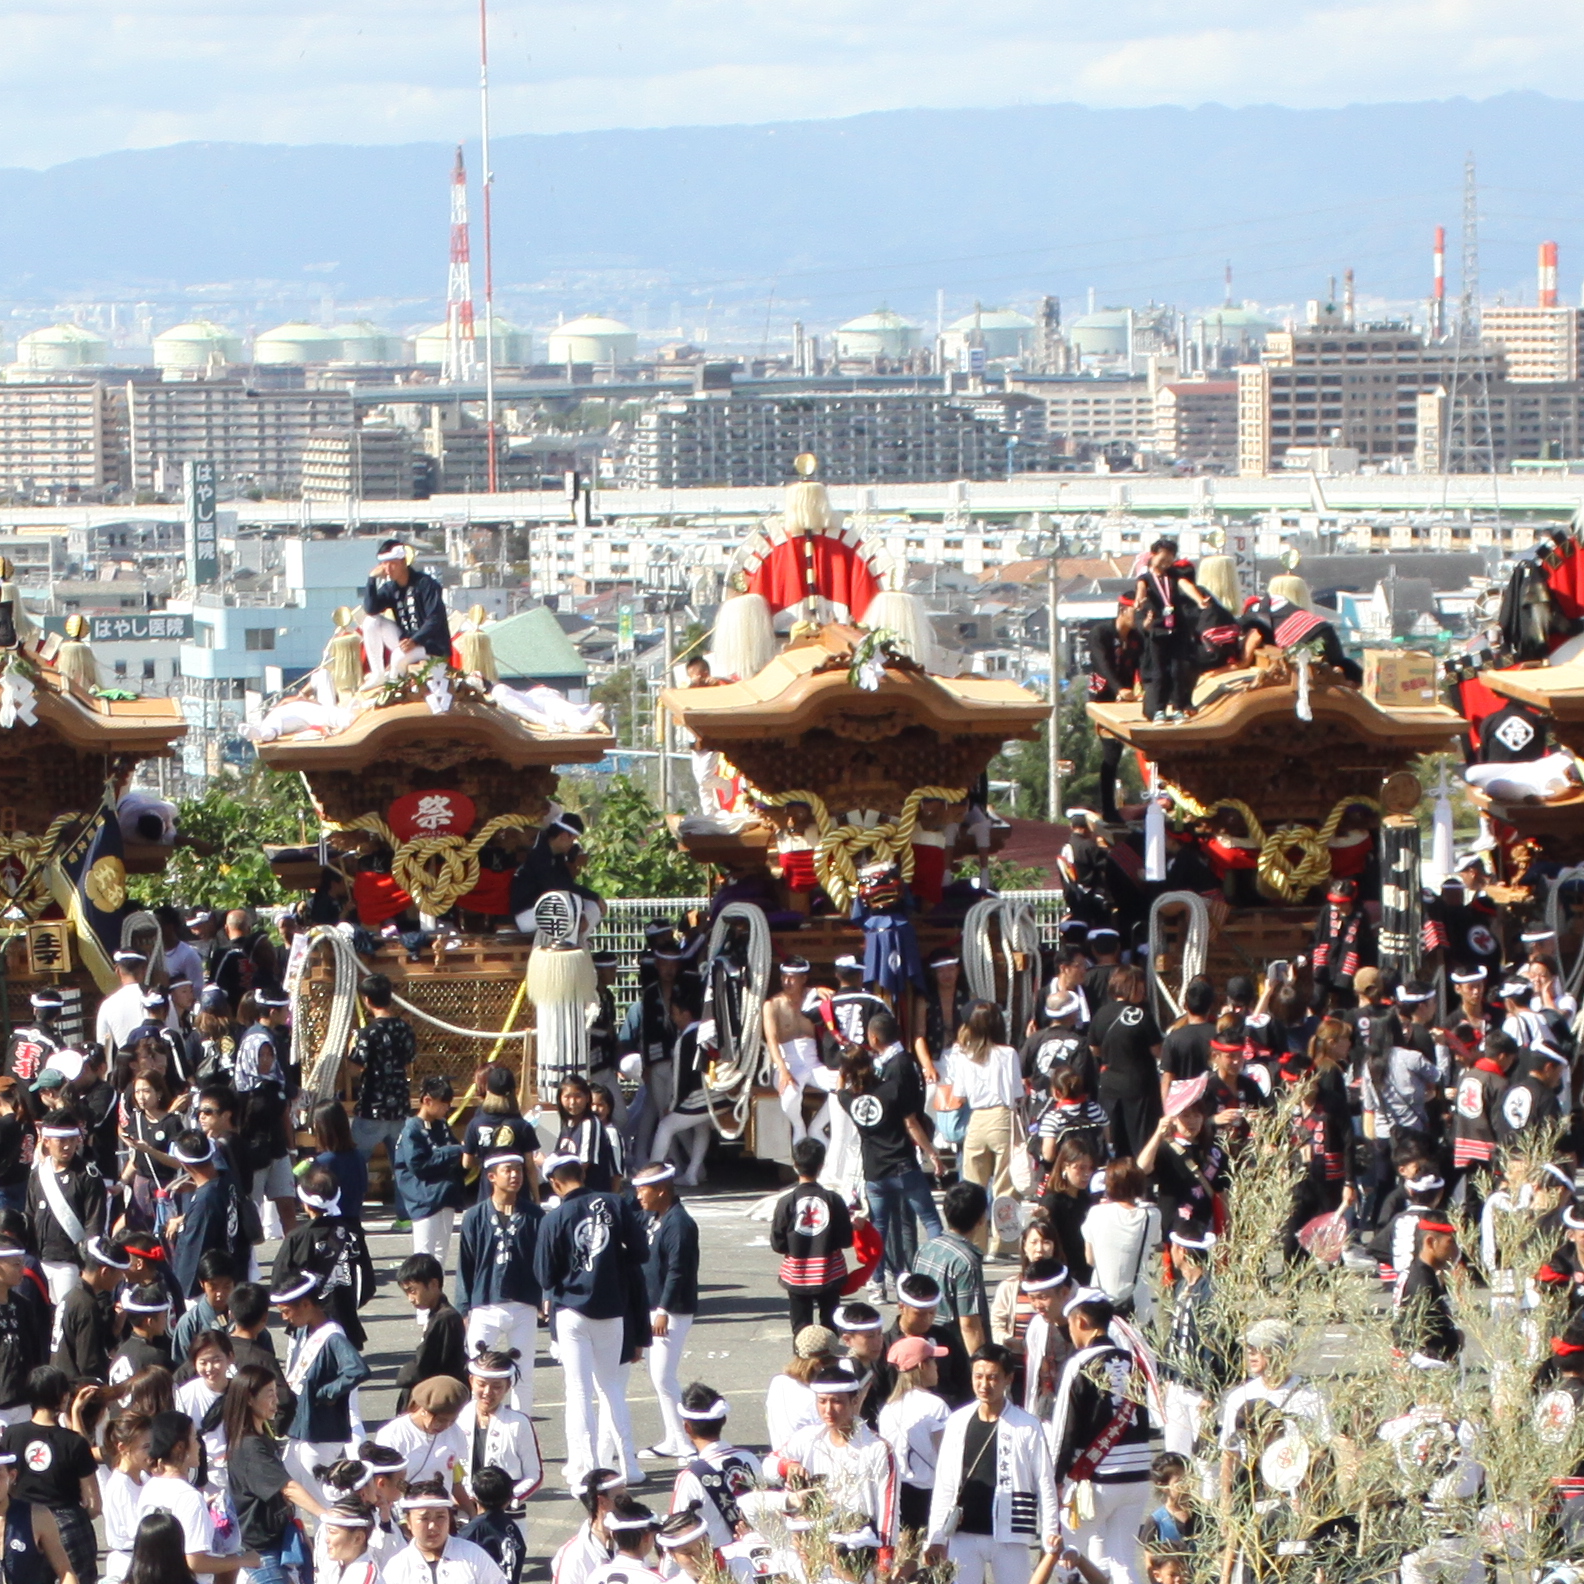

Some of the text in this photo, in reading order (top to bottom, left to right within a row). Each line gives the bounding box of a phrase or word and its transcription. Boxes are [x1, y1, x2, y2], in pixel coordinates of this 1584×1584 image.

[196, 464, 216, 560] はやし医院
[94, 618, 185, 638] はやし医院
[411, 794, 454, 830] 祭
